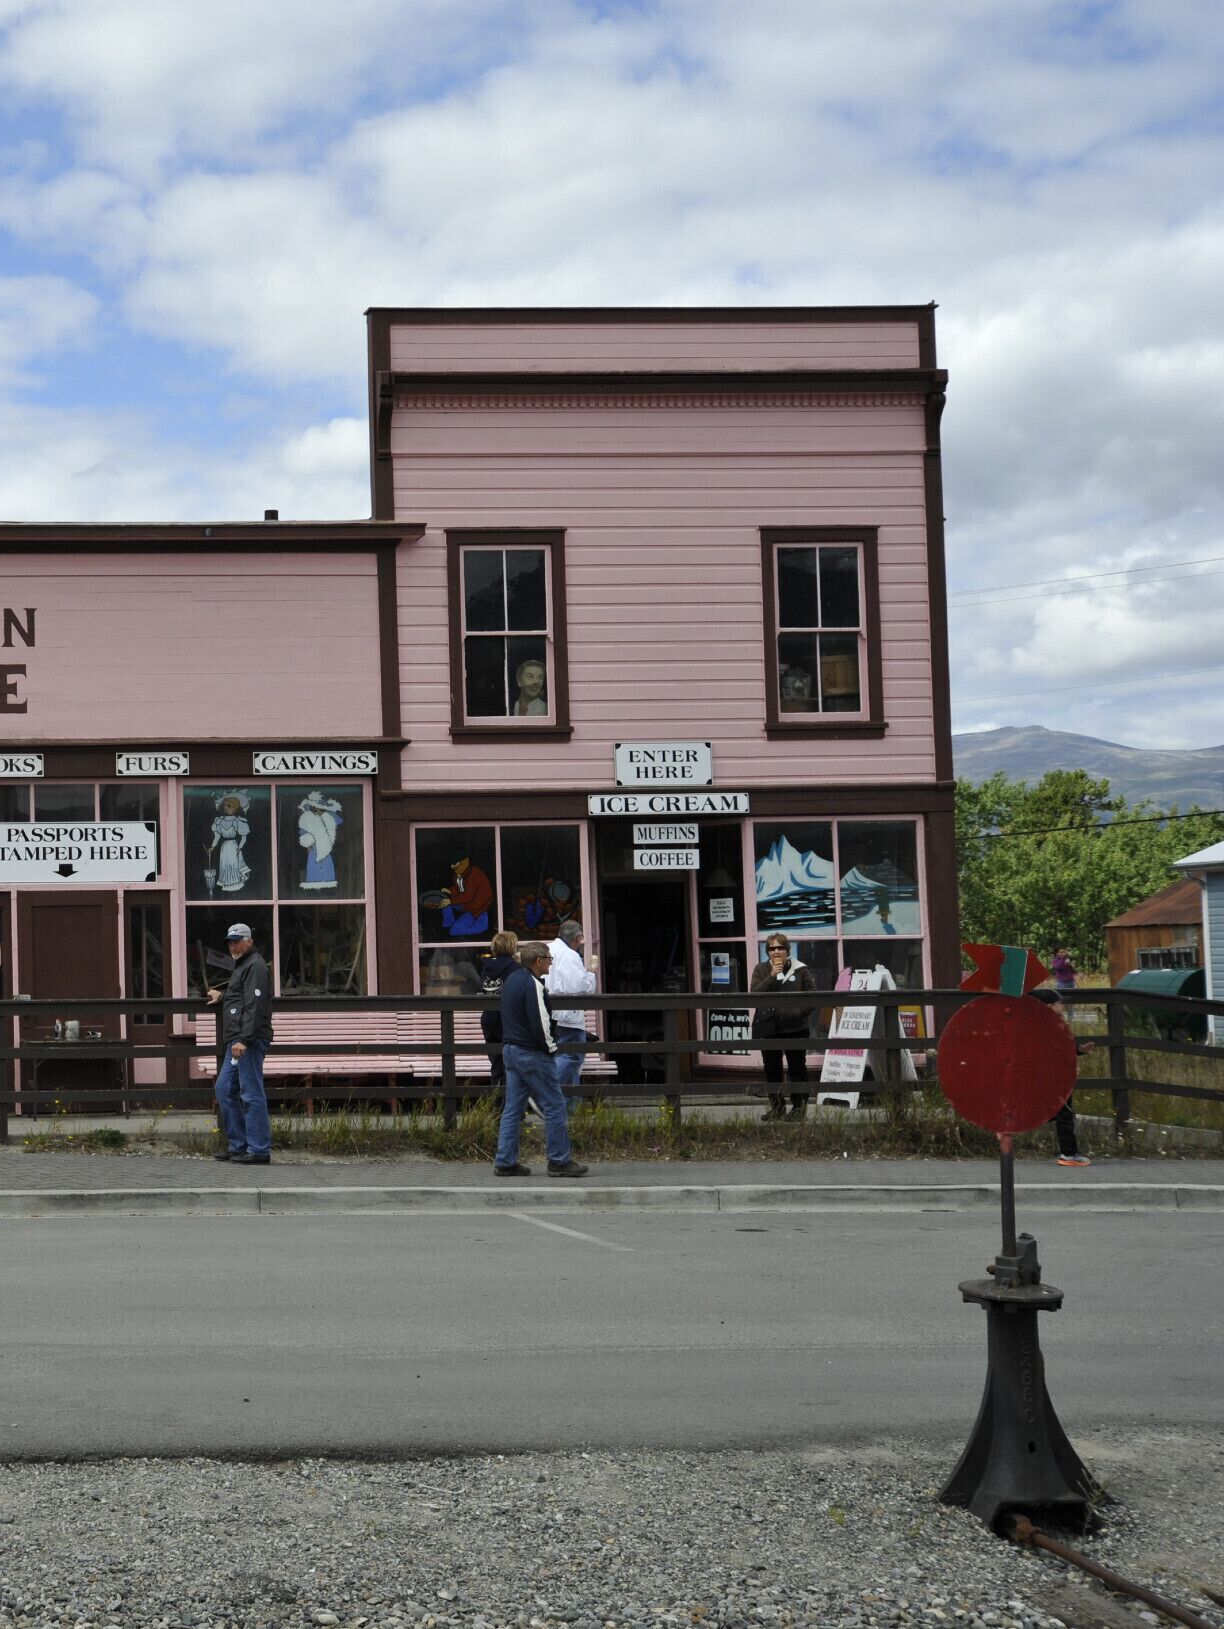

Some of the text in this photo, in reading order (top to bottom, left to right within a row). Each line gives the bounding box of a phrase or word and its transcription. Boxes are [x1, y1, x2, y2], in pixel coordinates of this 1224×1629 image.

[125, 756, 181, 771] FURS
[261, 754, 370, 771] CARVINGS
[629, 750, 698, 763] ENTER
[636, 765, 693, 779] HERE
[599, 795, 739, 812] ICE CREAM
[7, 827, 124, 842] PASSPORTS
[637, 826, 696, 840] MUFFINS
[90, 846, 148, 860] HERE
[639, 852, 694, 866] COFFEE
[711, 1013, 727, 1021] Come
[736, 1014, 749, 1022] we'r
[841, 1020, 871, 1031] ICE CREAM
[710, 1026, 752, 1054] OPEN
